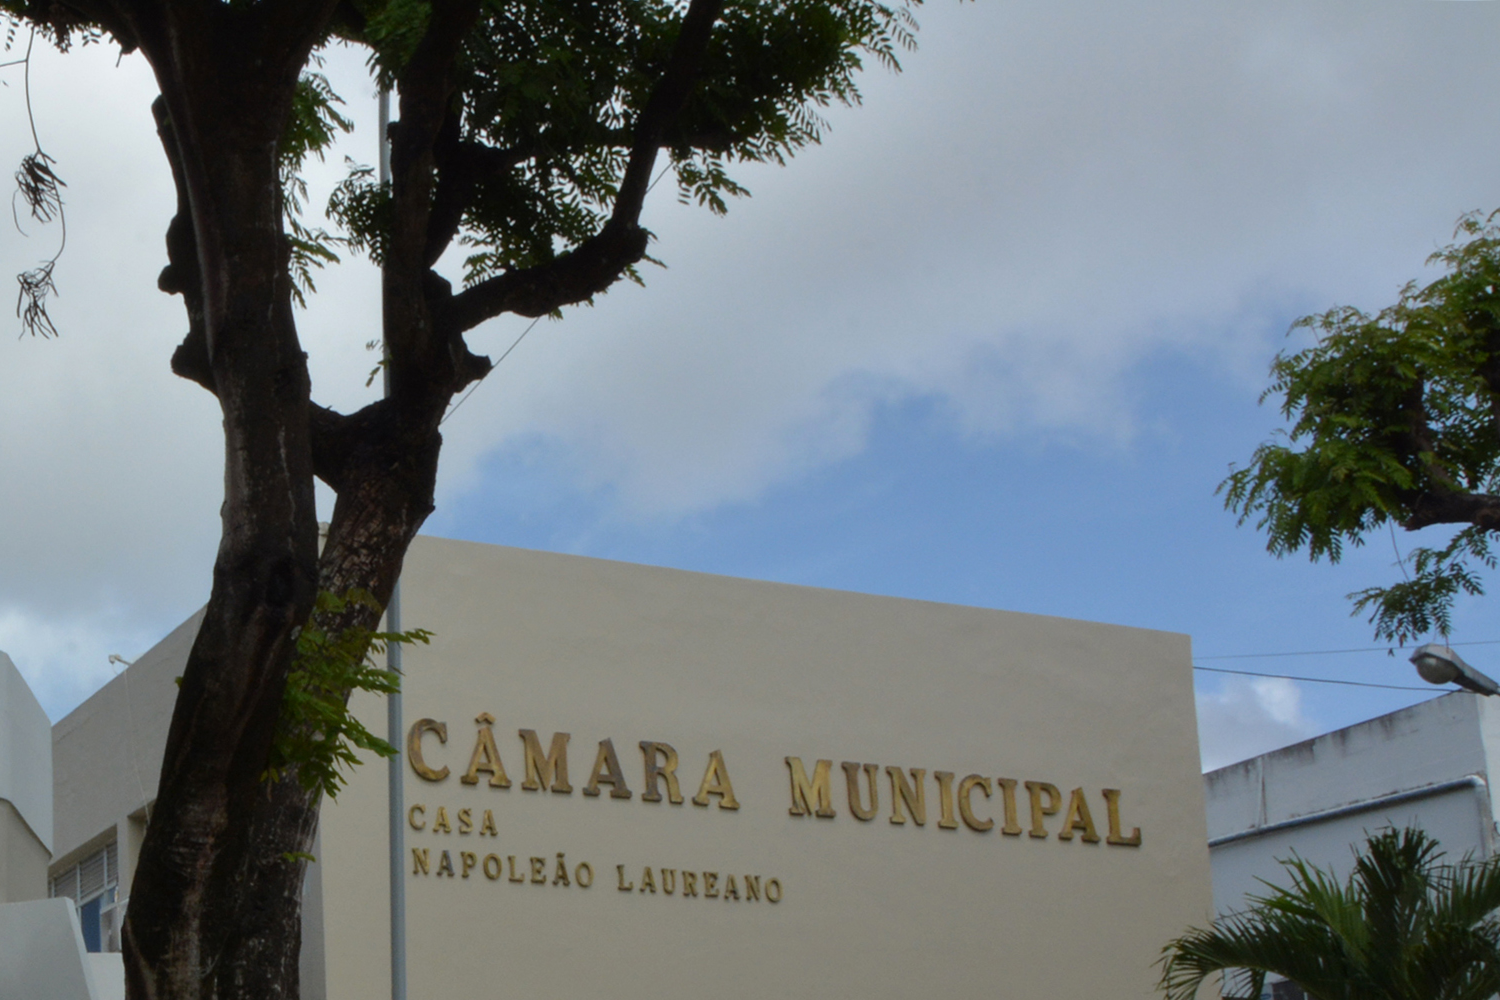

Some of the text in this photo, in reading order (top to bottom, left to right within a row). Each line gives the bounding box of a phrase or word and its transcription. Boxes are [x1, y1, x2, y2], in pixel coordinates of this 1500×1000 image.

[407, 712, 1142, 848] CÂMARA MUNICIPAL
[408, 803, 499, 837] CASA
[411, 847, 784, 903] NAPOLEÃO LAUREANO
